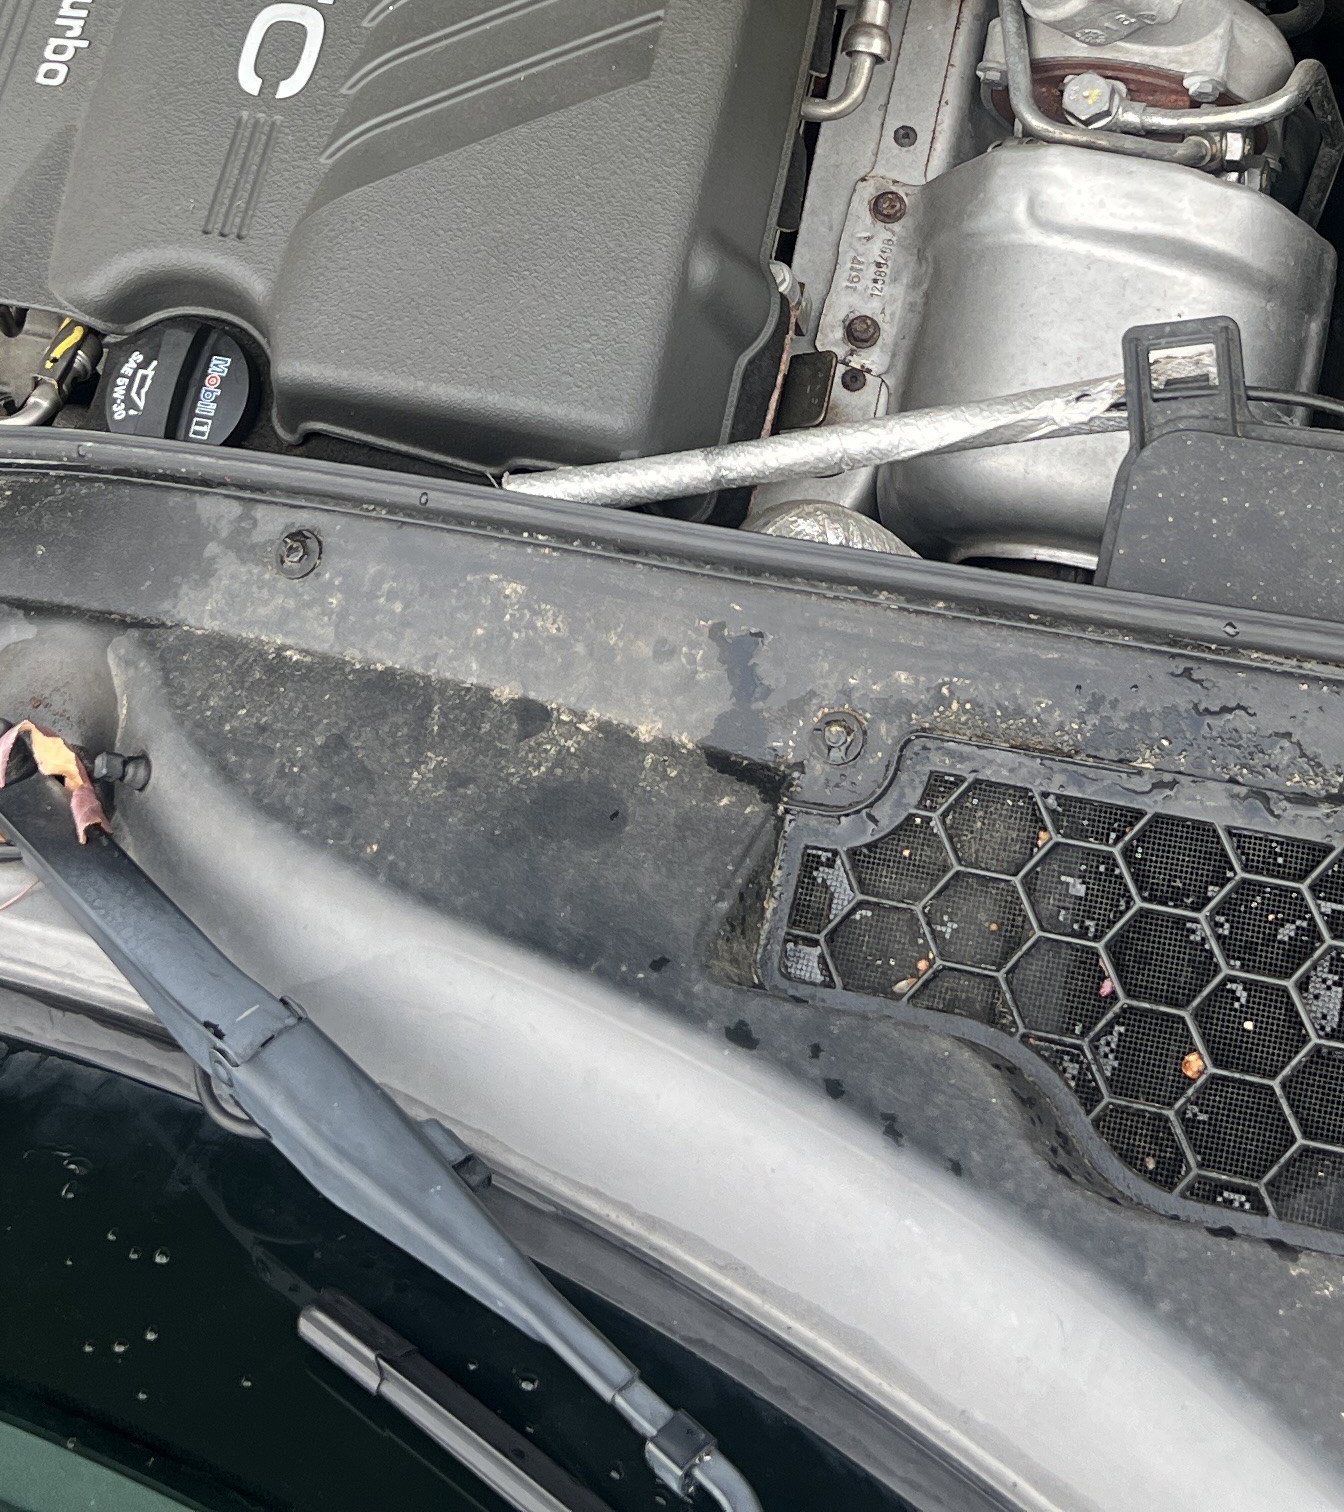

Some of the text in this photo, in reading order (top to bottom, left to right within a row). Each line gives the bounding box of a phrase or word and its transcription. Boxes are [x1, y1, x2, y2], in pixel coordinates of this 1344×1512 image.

[112, 351, 144, 420] SAE 5W-30
[195, 356, 231, 416] Mobil
